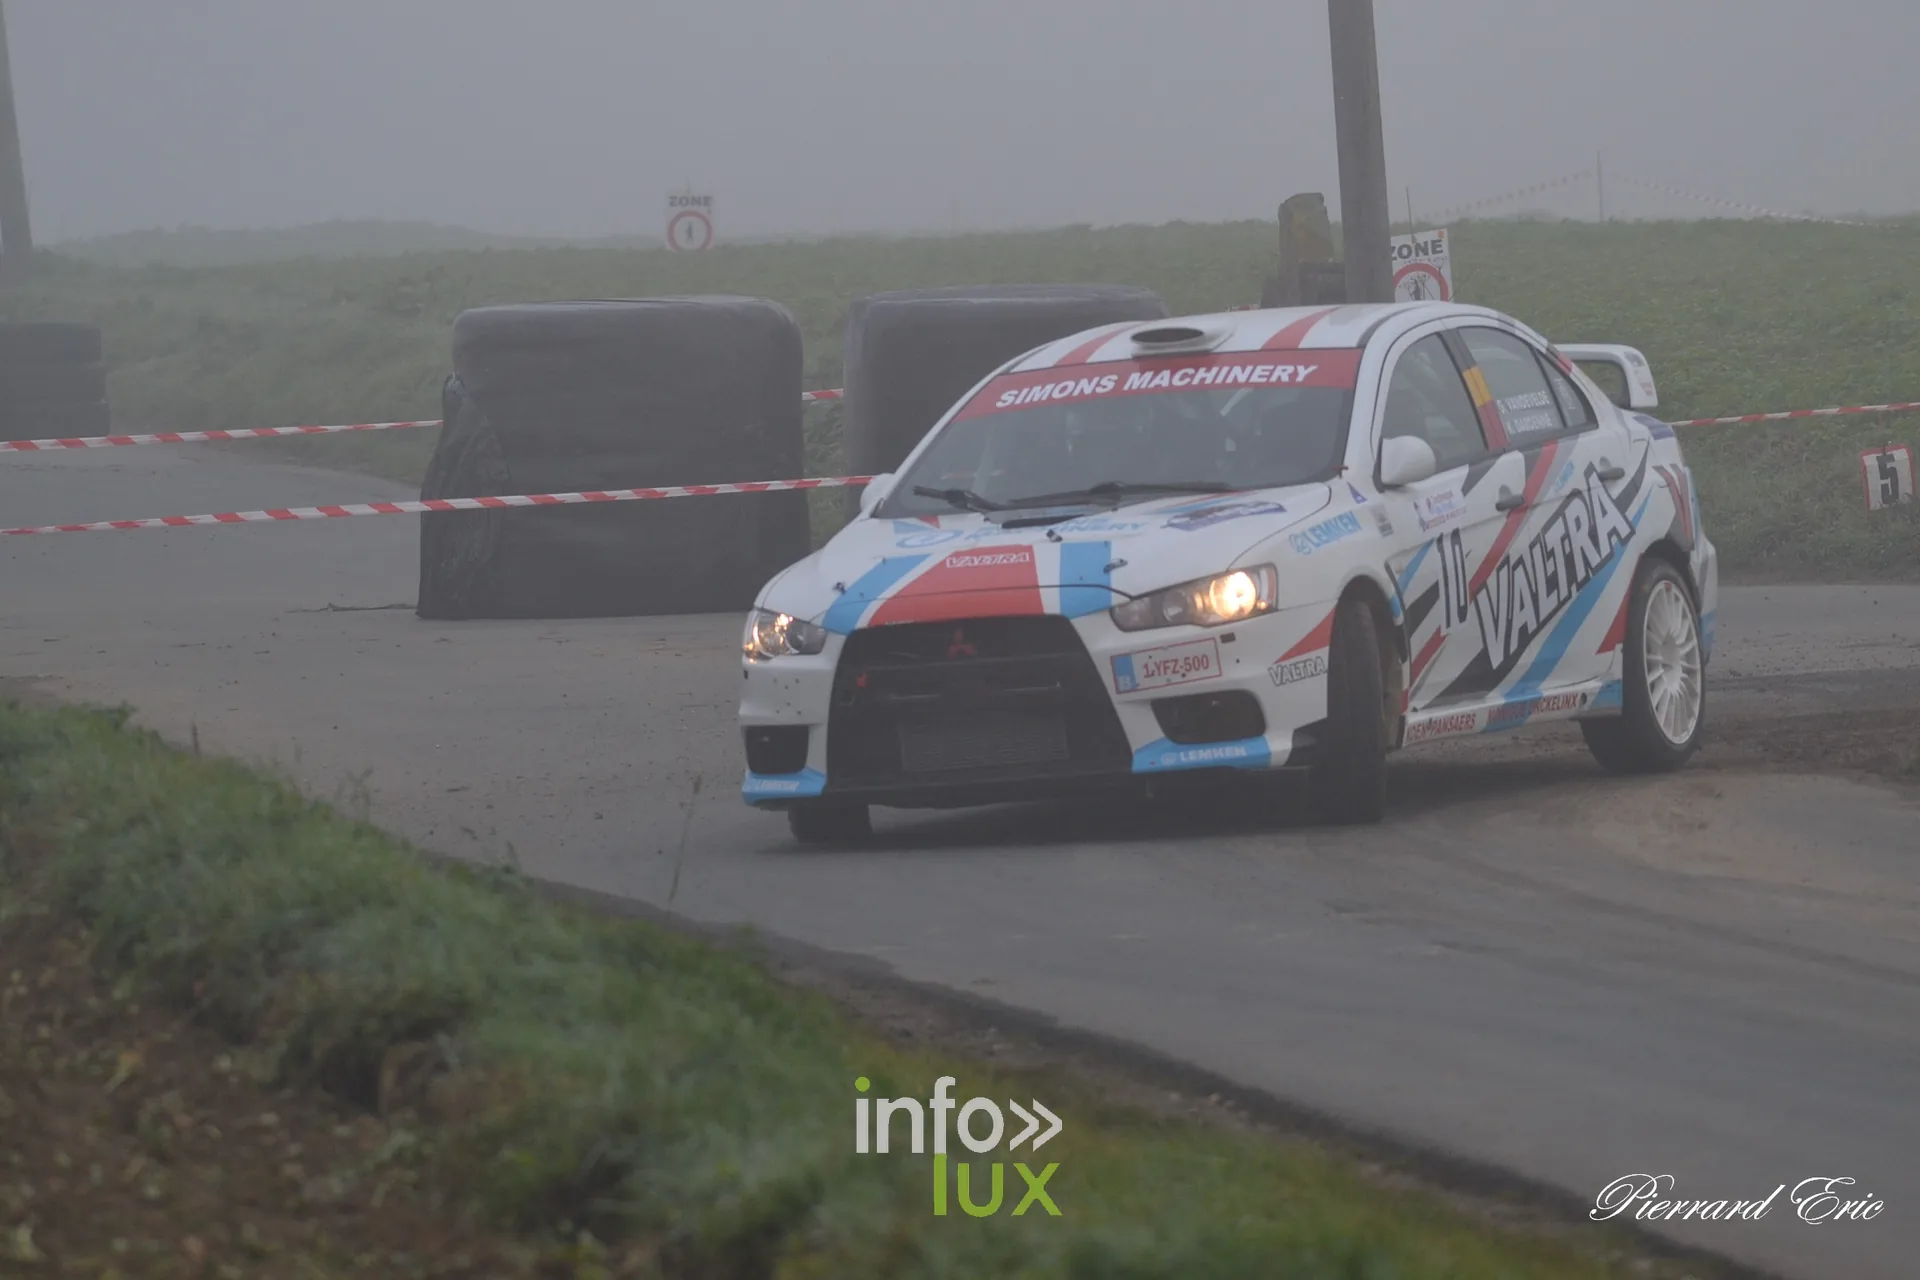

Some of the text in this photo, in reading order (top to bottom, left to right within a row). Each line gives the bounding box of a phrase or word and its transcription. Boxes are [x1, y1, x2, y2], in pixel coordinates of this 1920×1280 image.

[668, 195, 713, 207] ZONE
[1391, 239, 1444, 261] ZONE
[995, 364, 1318, 408] SIMONS MACHINERY
[1876, 453, 1900, 506] 5
[1301, 510, 1362, 548] LEMKEN
[1471, 462, 1636, 671] VALTRA
[1268, 656, 1329, 686] VALTRA
[1430, 712, 1476, 736] PANSAERS
[1180, 746, 1246, 762] LEMKEN
